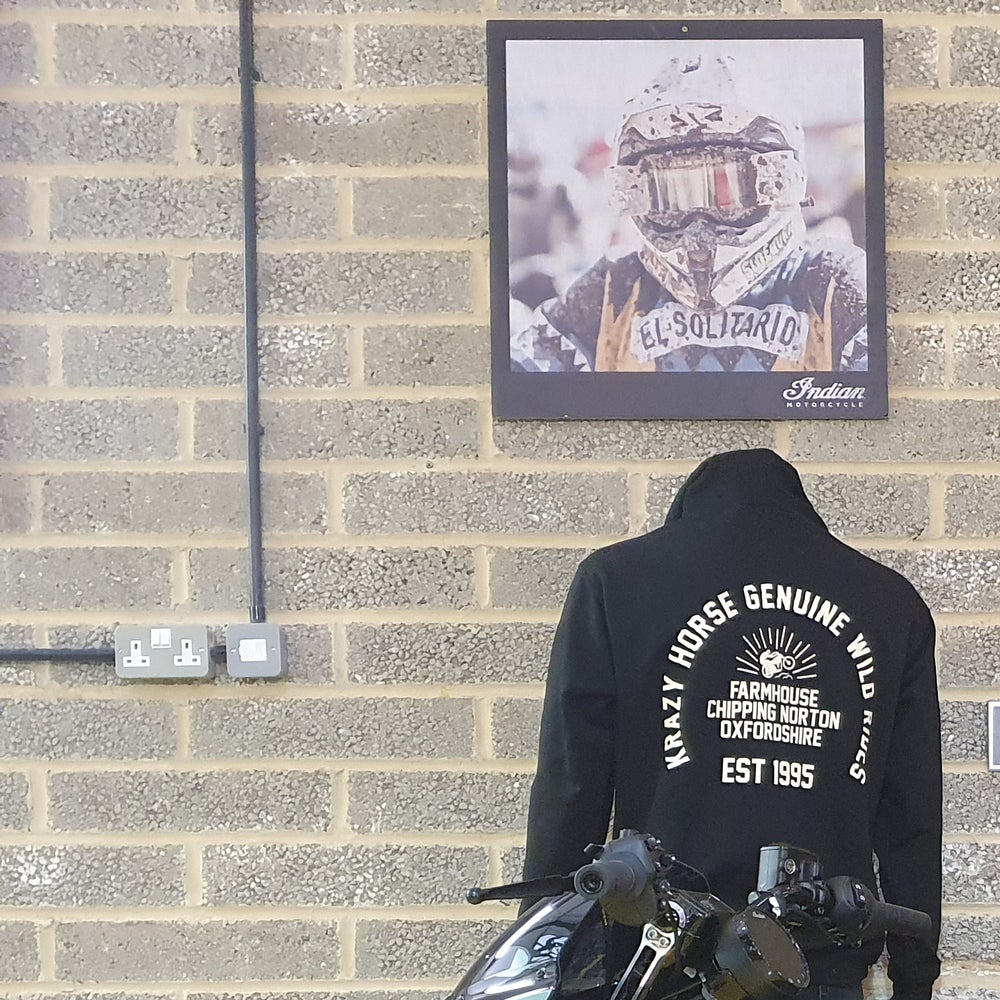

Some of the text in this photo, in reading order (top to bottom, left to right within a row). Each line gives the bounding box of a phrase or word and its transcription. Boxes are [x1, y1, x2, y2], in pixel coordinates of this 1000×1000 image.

[639, 310, 797, 350] EL SOLITARIO
[782, 376, 866, 400] Indian
[743, 583, 851, 637] GENUINE
[667, 590, 739, 669] HORSE
[846, 632, 875, 700] WILD
[729, 680, 820, 708] FARMHOUSE
[661, 675, 691, 770] KRAZY
[706, 699, 841, 730] CHIPPING NORTON
[720, 719, 823, 748] OXFORDSHIRE
[721, 757, 815, 789] EST 1995
